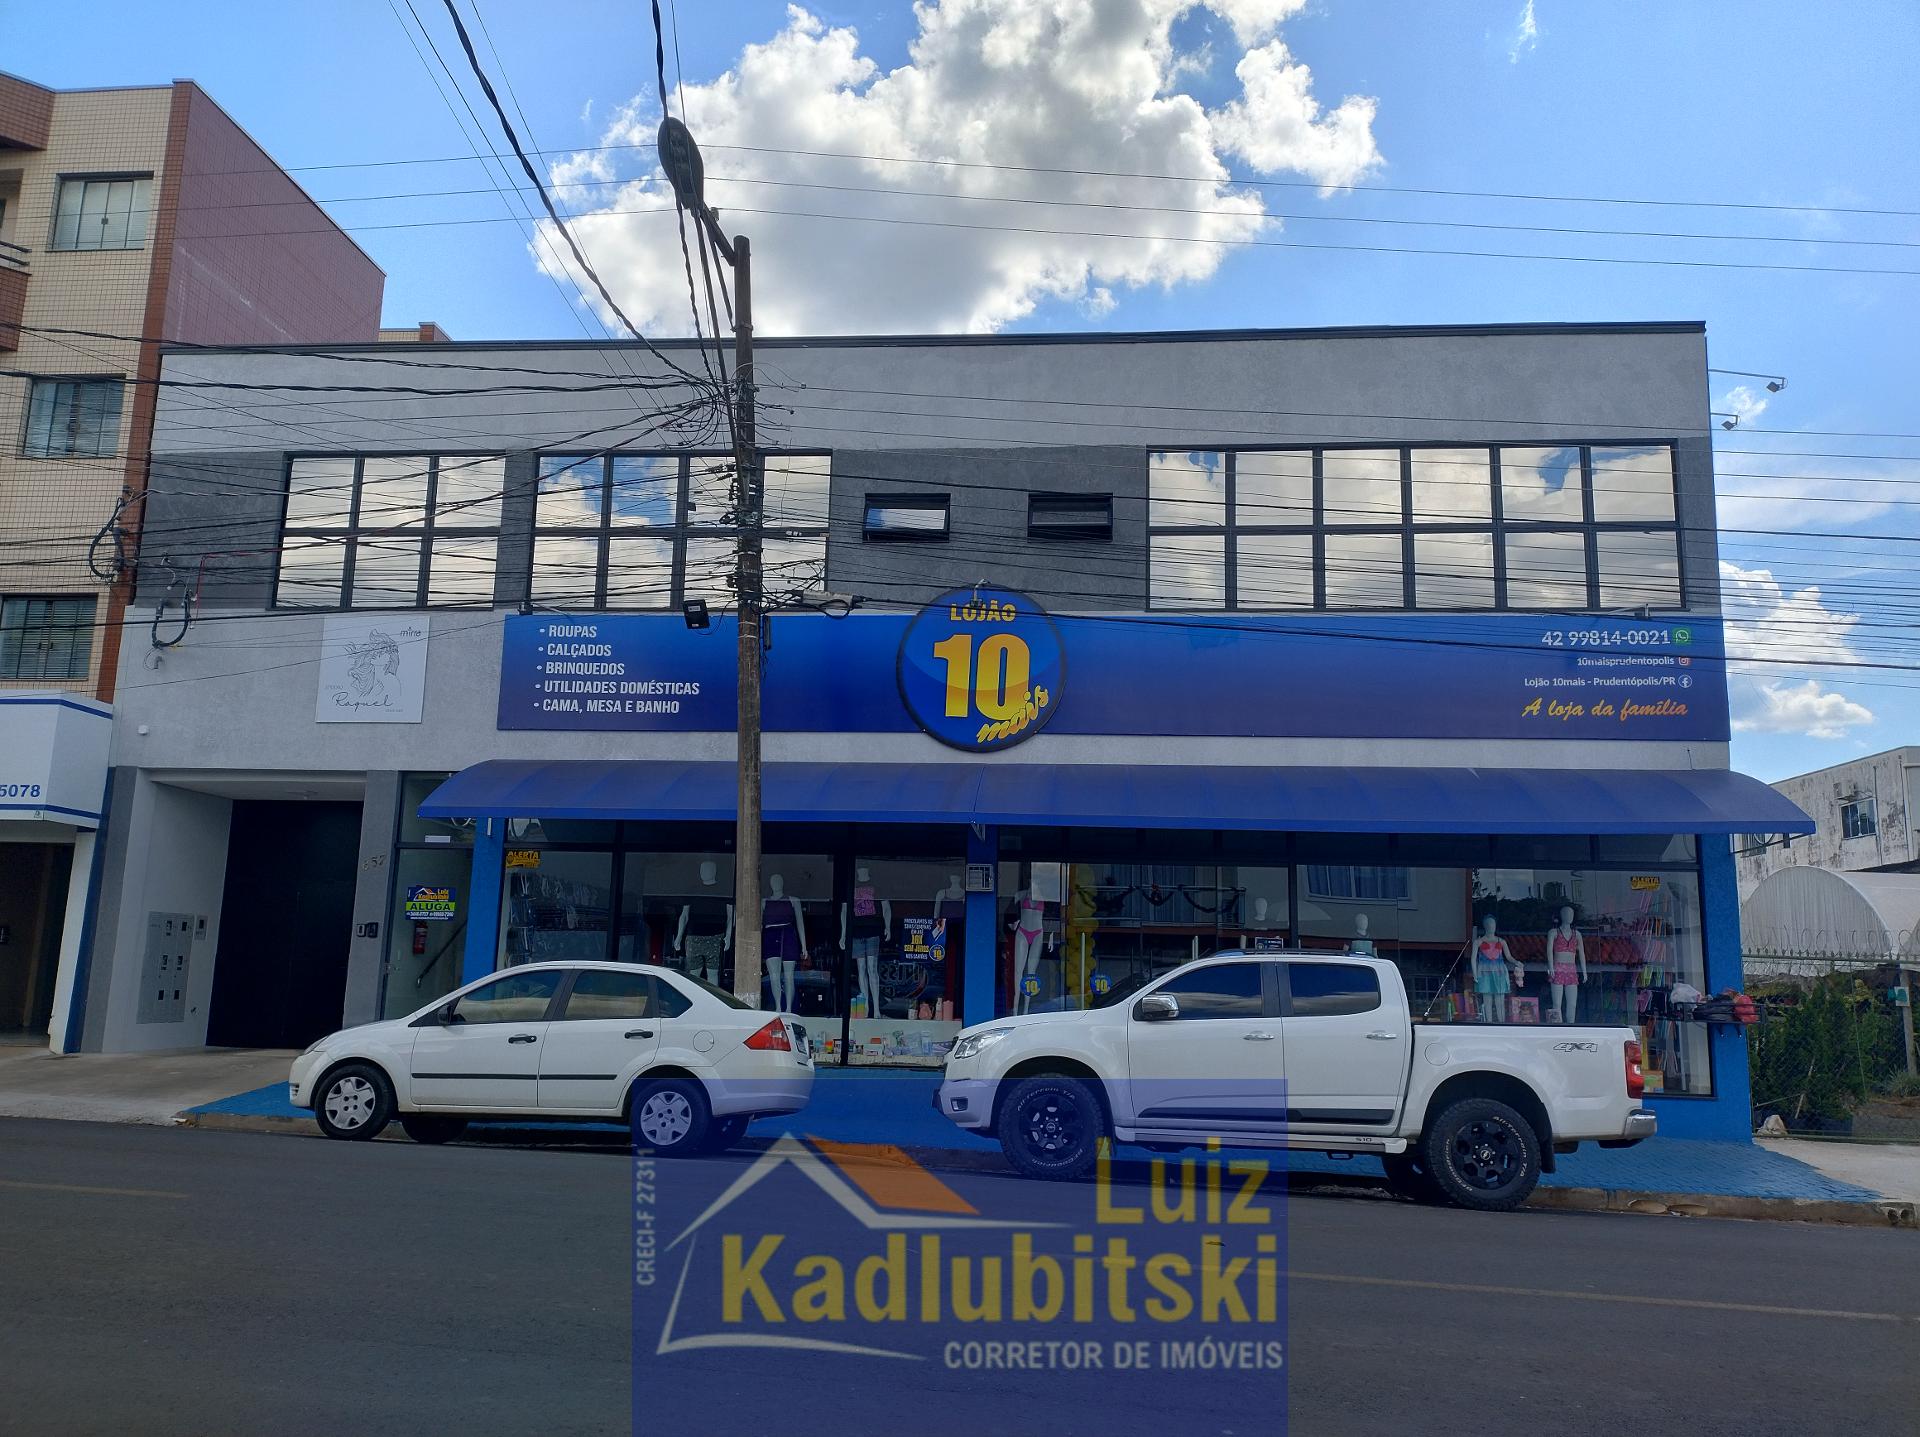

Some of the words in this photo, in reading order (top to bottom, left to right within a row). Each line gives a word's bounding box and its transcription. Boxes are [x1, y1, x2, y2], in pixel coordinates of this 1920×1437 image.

[950, 599, 1016, 621] LOJÃO
[548, 625, 598, 638] ROUPAS
[1541, 631, 1563, 646] 42
[1567, 629, 1671, 646] 99814-0021
[547, 643, 612, 657] CALÇADOS
[545, 662, 625, 675] BRINQUEDOS
[1577, 656, 1675, 667] 10maisprudentopolis
[933, 633, 1031, 721] 10
[1524, 677, 1550, 687] Lojão
[1552, 677, 1586, 686] 10mais
[1593, 676, 1676, 687] Prudentópolis/PR
[544, 680, 617, 694] UTILIDADES
[620, 680, 700, 695] DOMÉSTICAS
[332, 691, 394, 712] Raquel
[542, 699, 583, 714] CAMA,
[586, 700, 622, 713] MESA
[625, 700, 633, 713] E
[635, 700, 680, 714] BANHO
[976, 685, 1049, 744] mais
[1521, 697, 1543, 718] A
[1548, 699, 1585, 721] loja
[1591, 699, 1615, 716] da
[1620, 698, 1688, 722] família
[0, 784, 41, 798] 5078
[410, 903, 451, 911] ALUGA
[1095, 979, 1108, 992] 10
